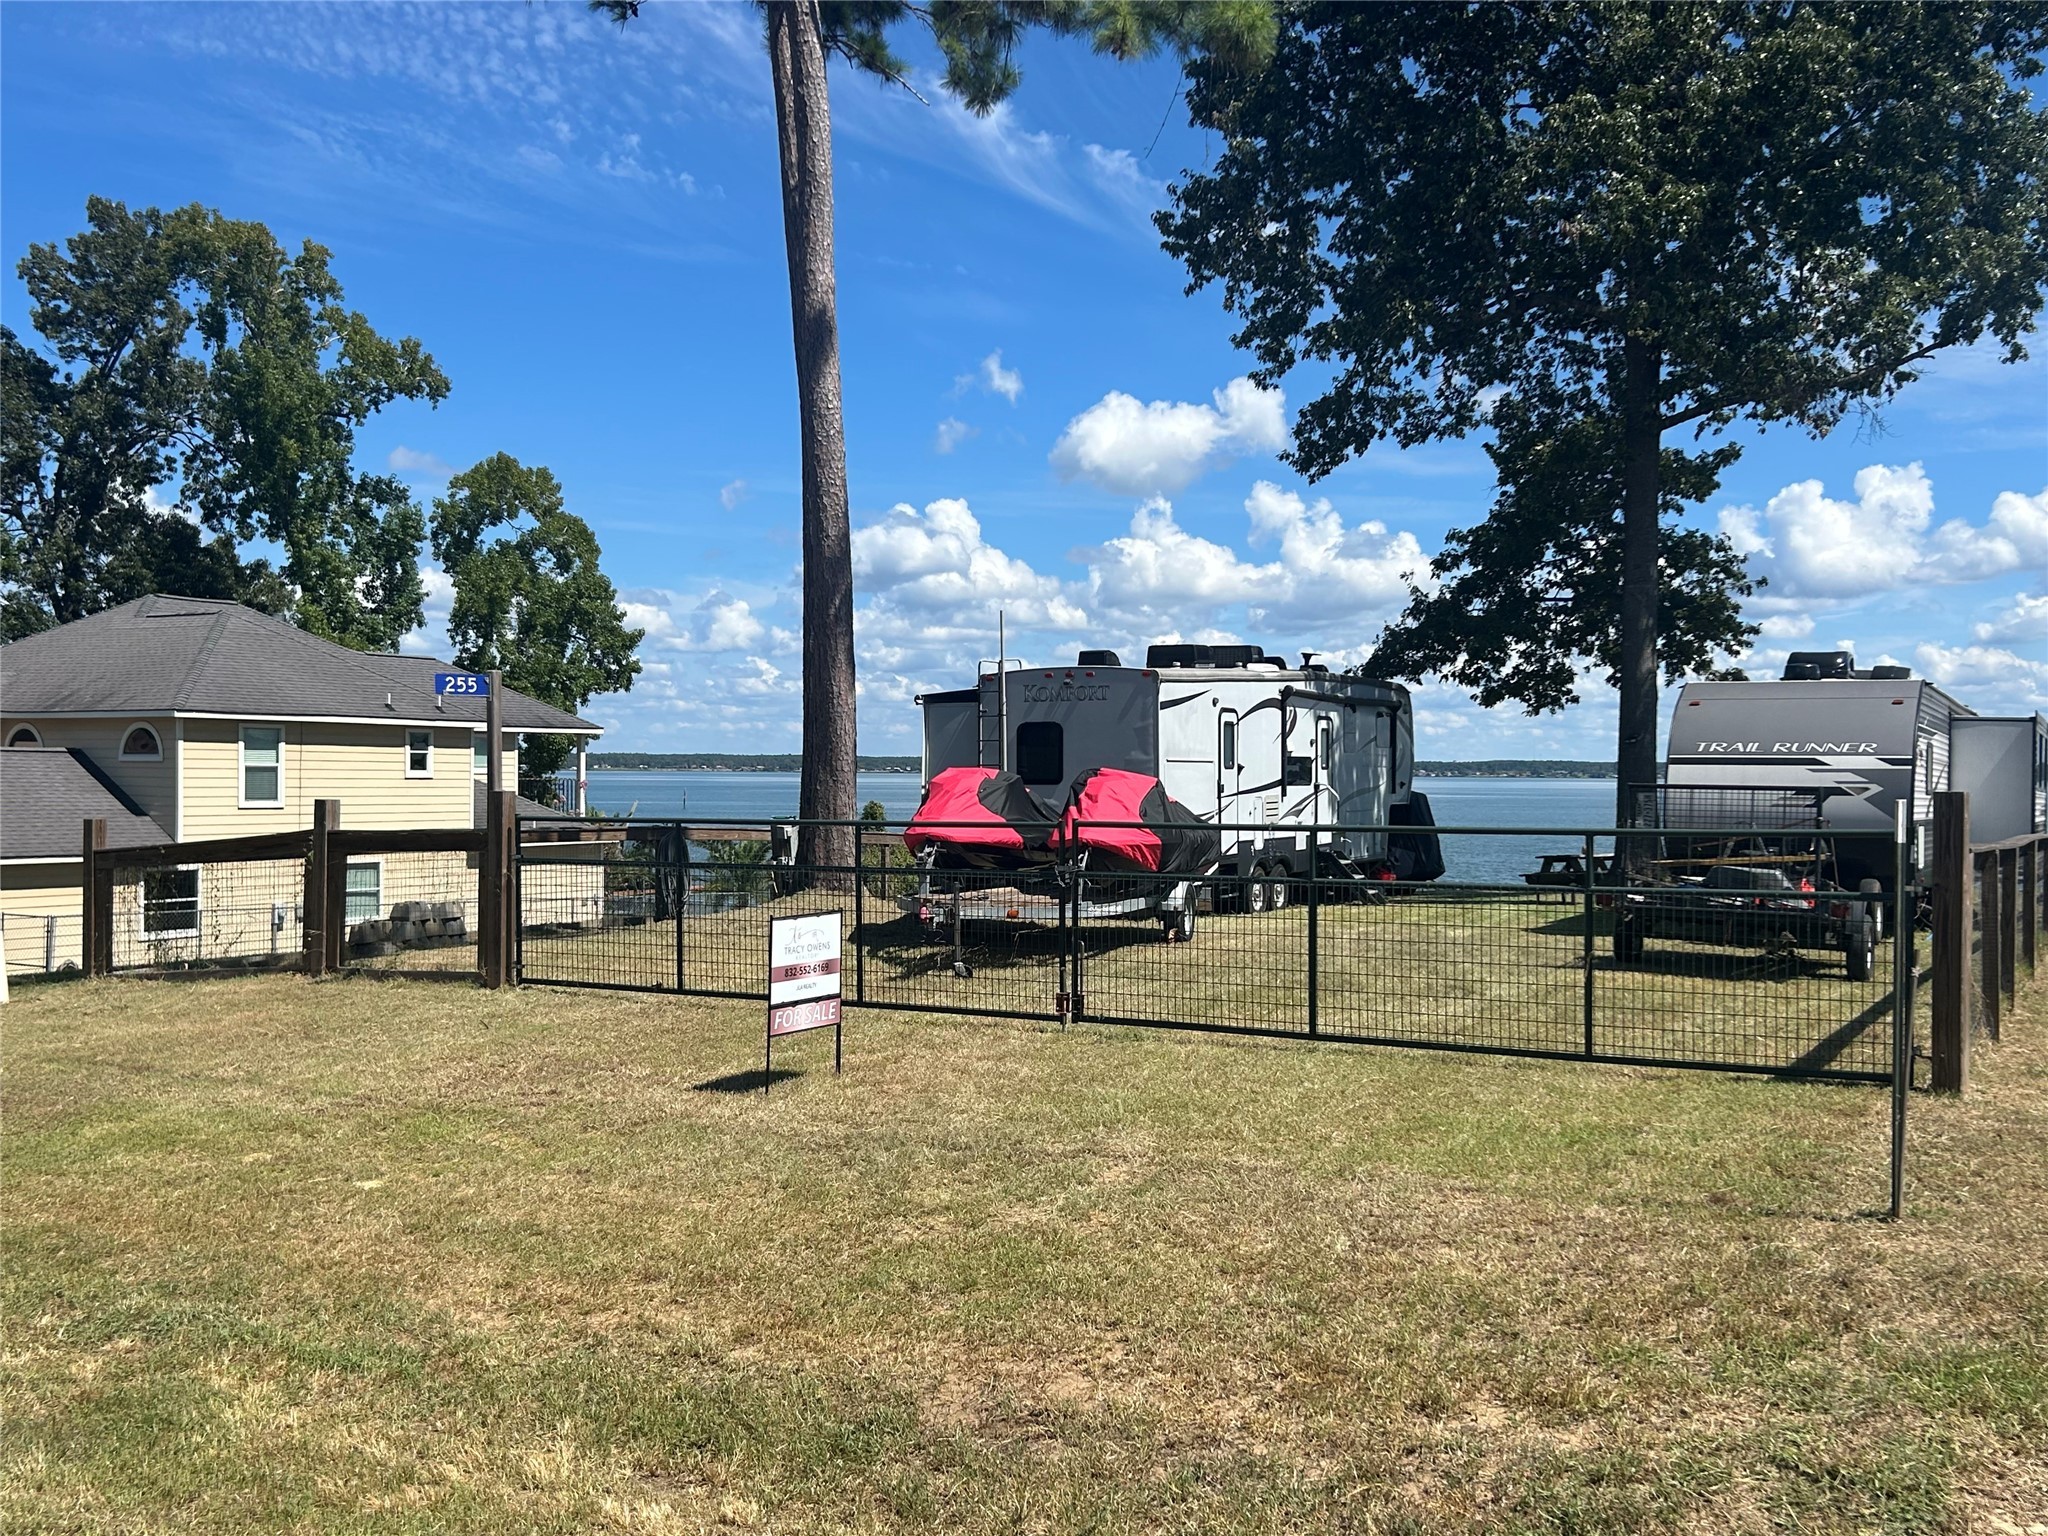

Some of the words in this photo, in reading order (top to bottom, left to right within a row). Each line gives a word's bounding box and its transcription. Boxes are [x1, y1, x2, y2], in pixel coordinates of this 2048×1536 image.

[445, 676, 477, 693] 255
[1023, 684, 1110, 702] KOMFORT
[1695, 742, 1764, 752] TRAIL
[1772, 742, 1878, 753] RUNNER
[784, 944, 805, 955] TRACY
[807, 941, 831, 953] OWENS
[784, 962, 829, 978] 832-552-6169
[774, 1008, 803, 1030] FOR
[804, 1001, 837, 1025] SALE
